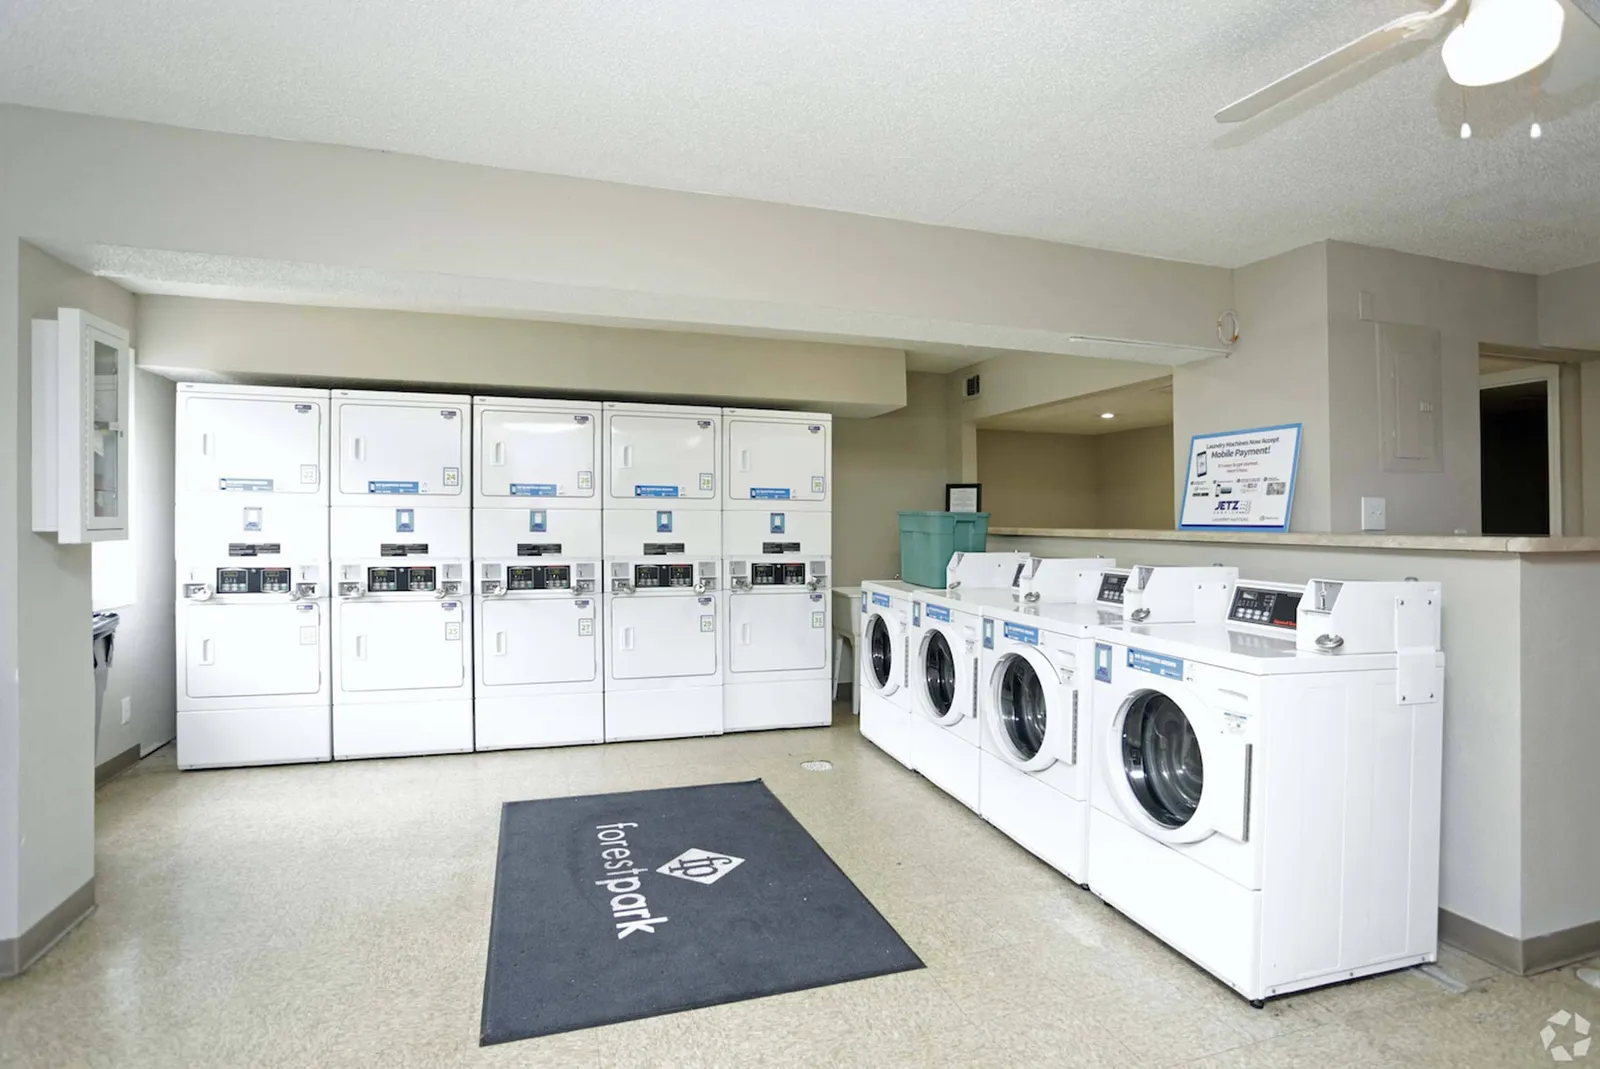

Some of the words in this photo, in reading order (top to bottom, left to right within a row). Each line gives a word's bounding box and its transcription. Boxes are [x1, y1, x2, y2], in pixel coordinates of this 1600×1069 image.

[1206, 442, 1225, 450] Laundry
[1211, 449, 1234, 459] Mobile
[1234, 446, 1271, 458] Payment!
[1215, 500, 1239, 510] JETZ
